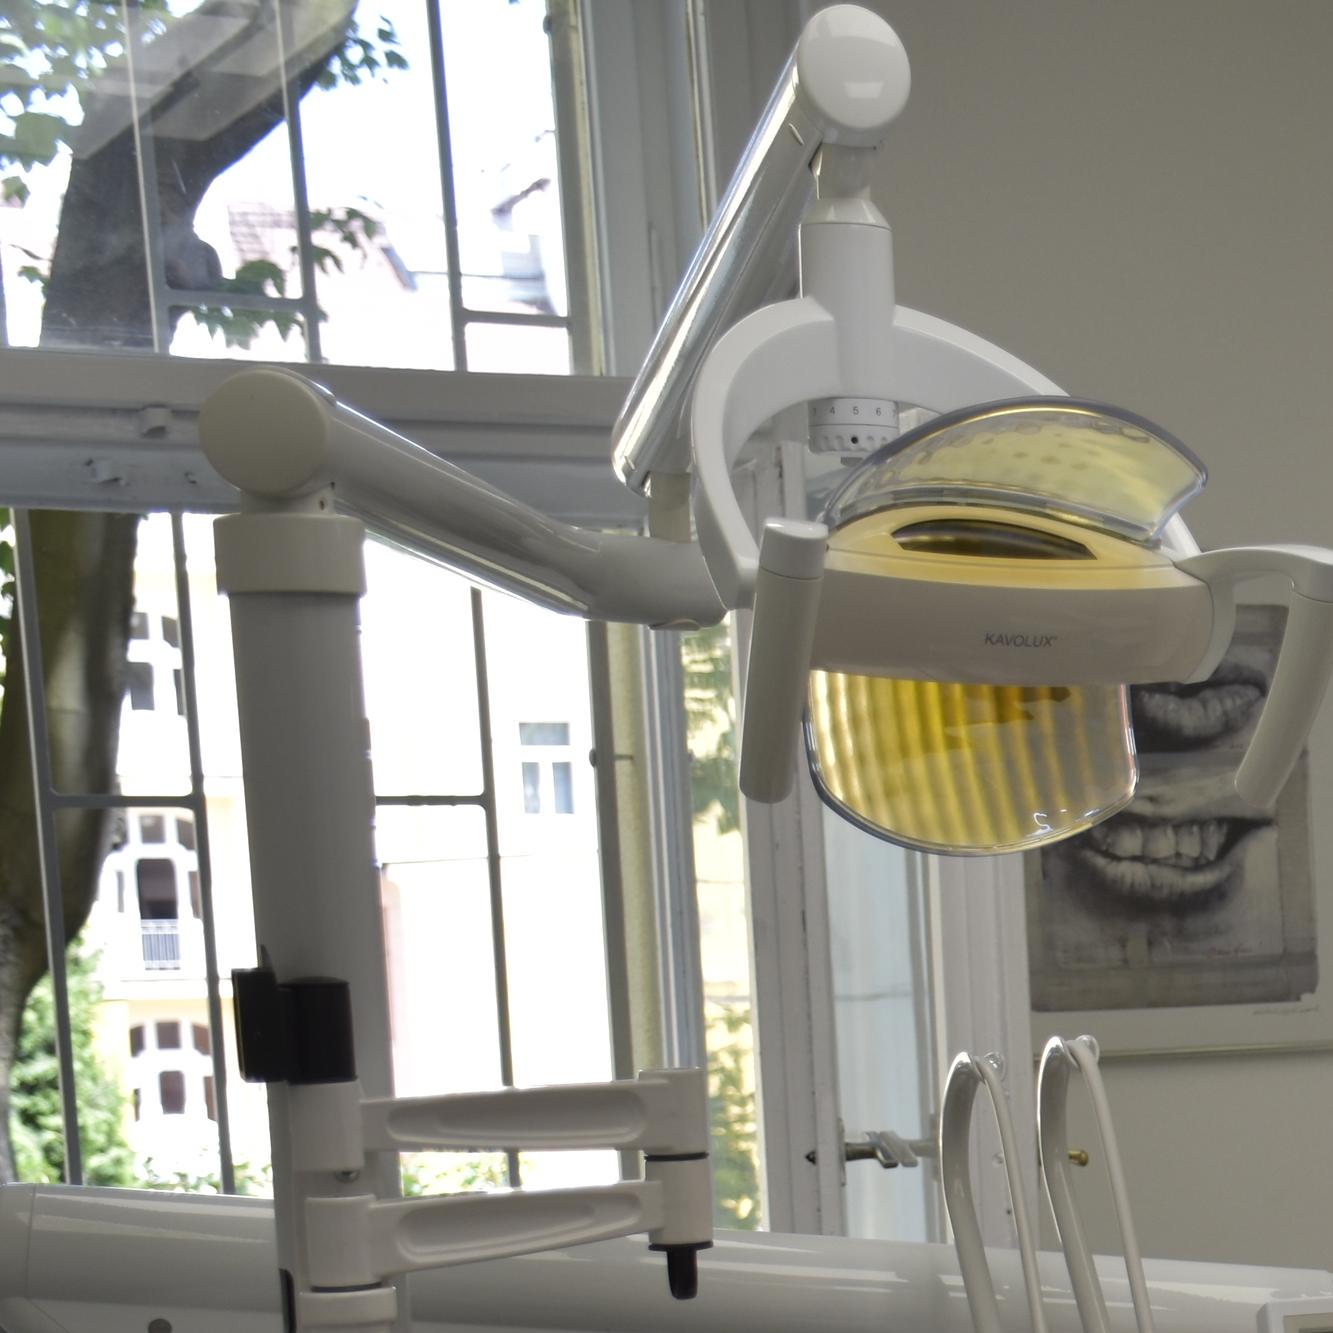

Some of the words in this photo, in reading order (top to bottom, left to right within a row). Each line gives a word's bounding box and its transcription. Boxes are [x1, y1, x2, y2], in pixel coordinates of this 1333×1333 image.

[852, 406, 859, 415] 5
[876, 407, 882, 416] 6
[984, 632, 1055, 648] KAVOLUX
